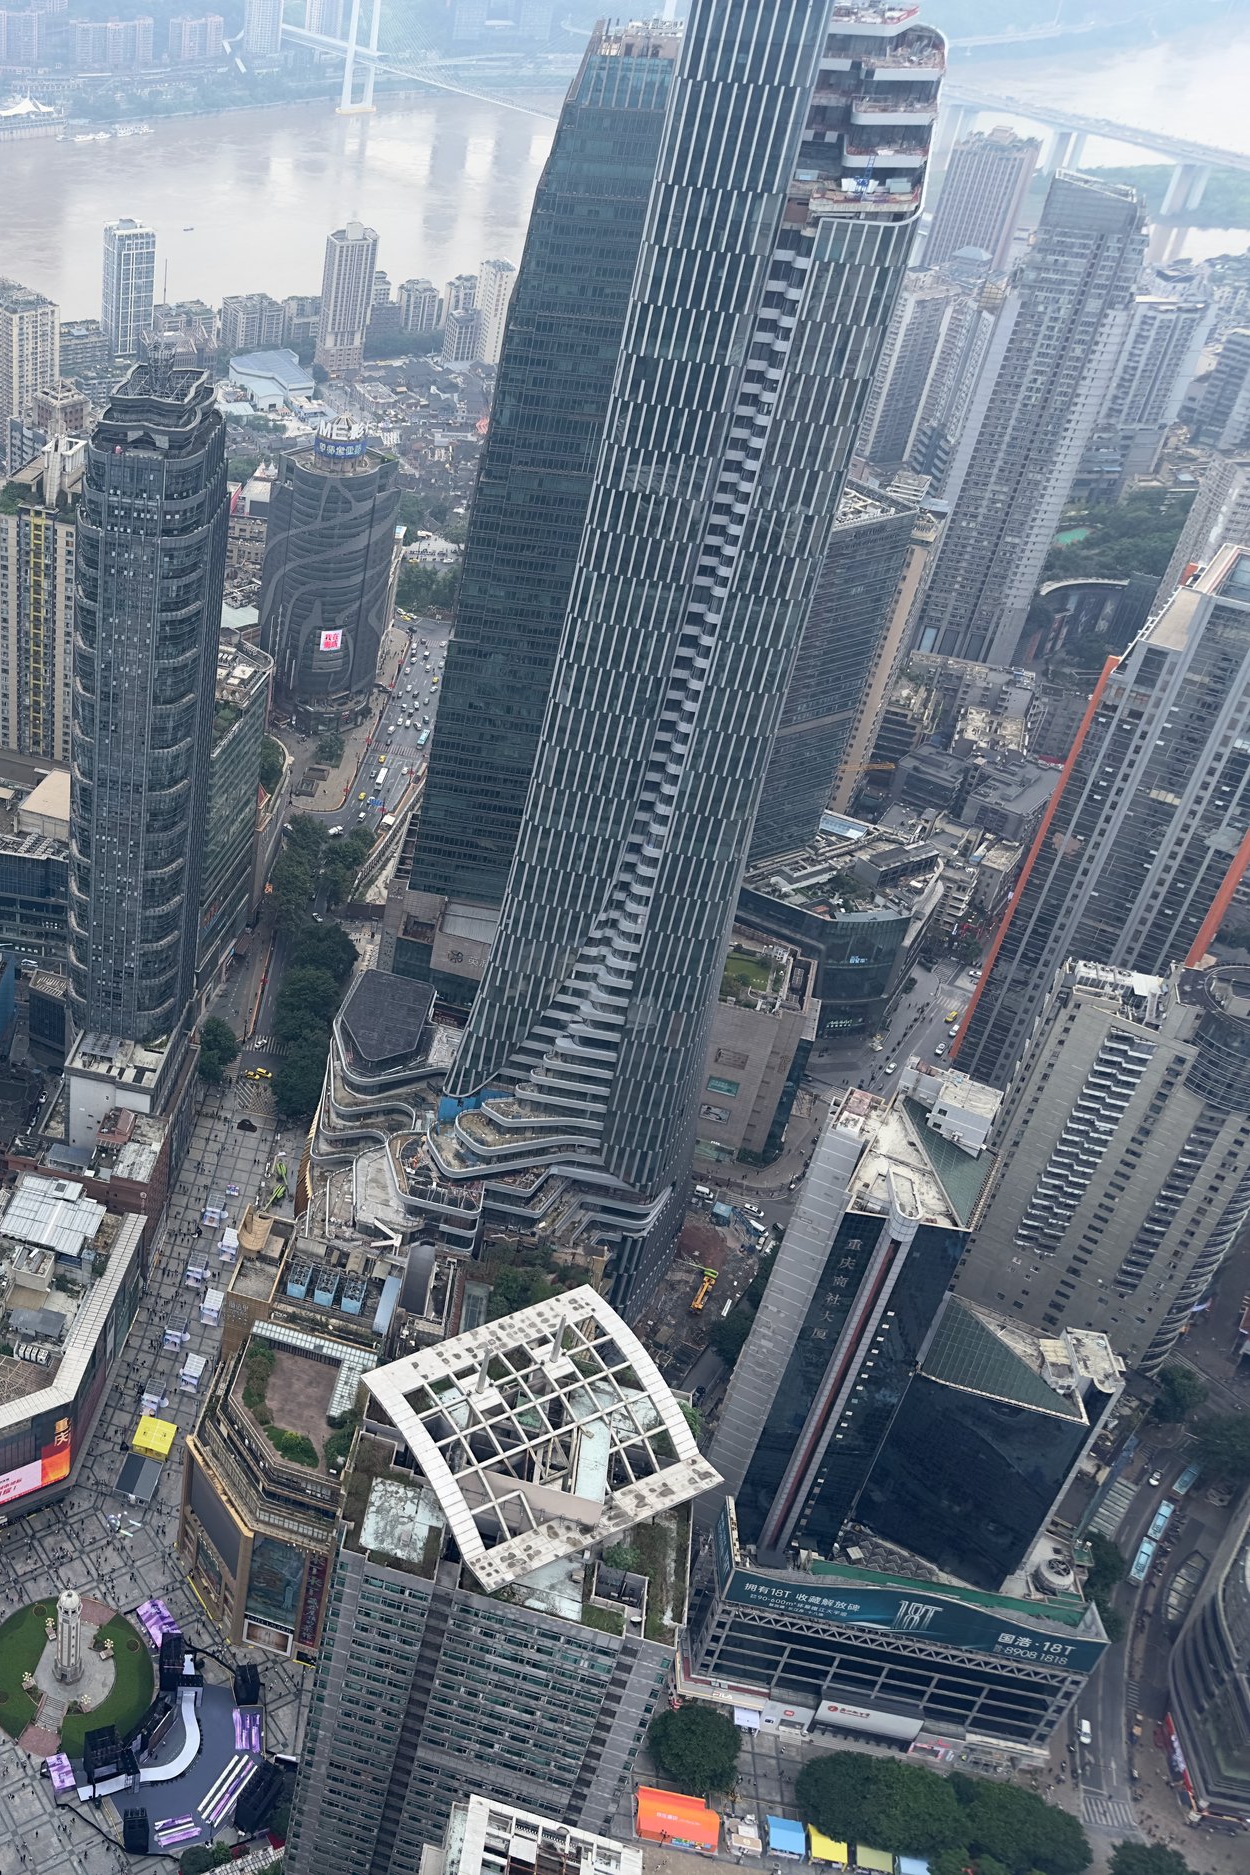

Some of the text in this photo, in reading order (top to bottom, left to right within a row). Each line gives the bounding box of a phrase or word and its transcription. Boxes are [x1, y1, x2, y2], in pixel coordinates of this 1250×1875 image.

[812, 1239, 863, 1340] 重庆商社大厦
[744, 1582, 860, 1612] 拥有18T 收藏解放碑
[894, 1600, 943, 1630] 18T
[1004, 1646, 1038, 1659] 8908
[1039, 1653, 1069, 1665] 1818
[712, 1688, 733, 1700] FILA
